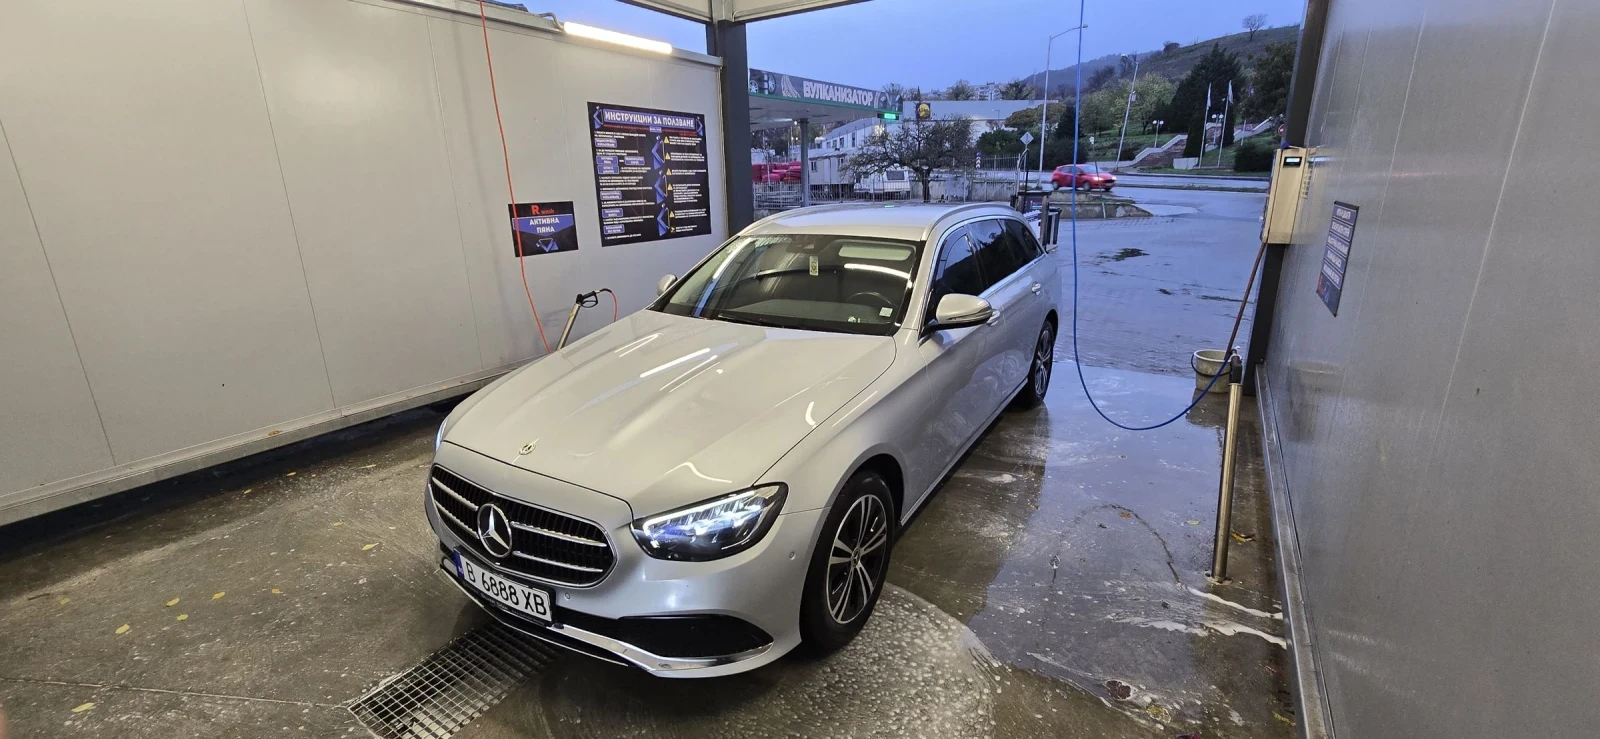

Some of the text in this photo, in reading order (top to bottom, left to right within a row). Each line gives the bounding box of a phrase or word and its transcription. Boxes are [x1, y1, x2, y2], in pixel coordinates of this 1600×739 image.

[803, 80, 873, 106] ВУЛКАНИЗАТОР
[604, 111, 694, 128] ИНСТРУКЦИИ ЗА ПОЛЗВАНЕ
[531, 204, 540, 215] R
[529, 217, 560, 226] АКТИВНА
[536, 226, 555, 234] ПЯНА
[466, 562, 476, 583] B
[481, 572, 519, 606] 6888
